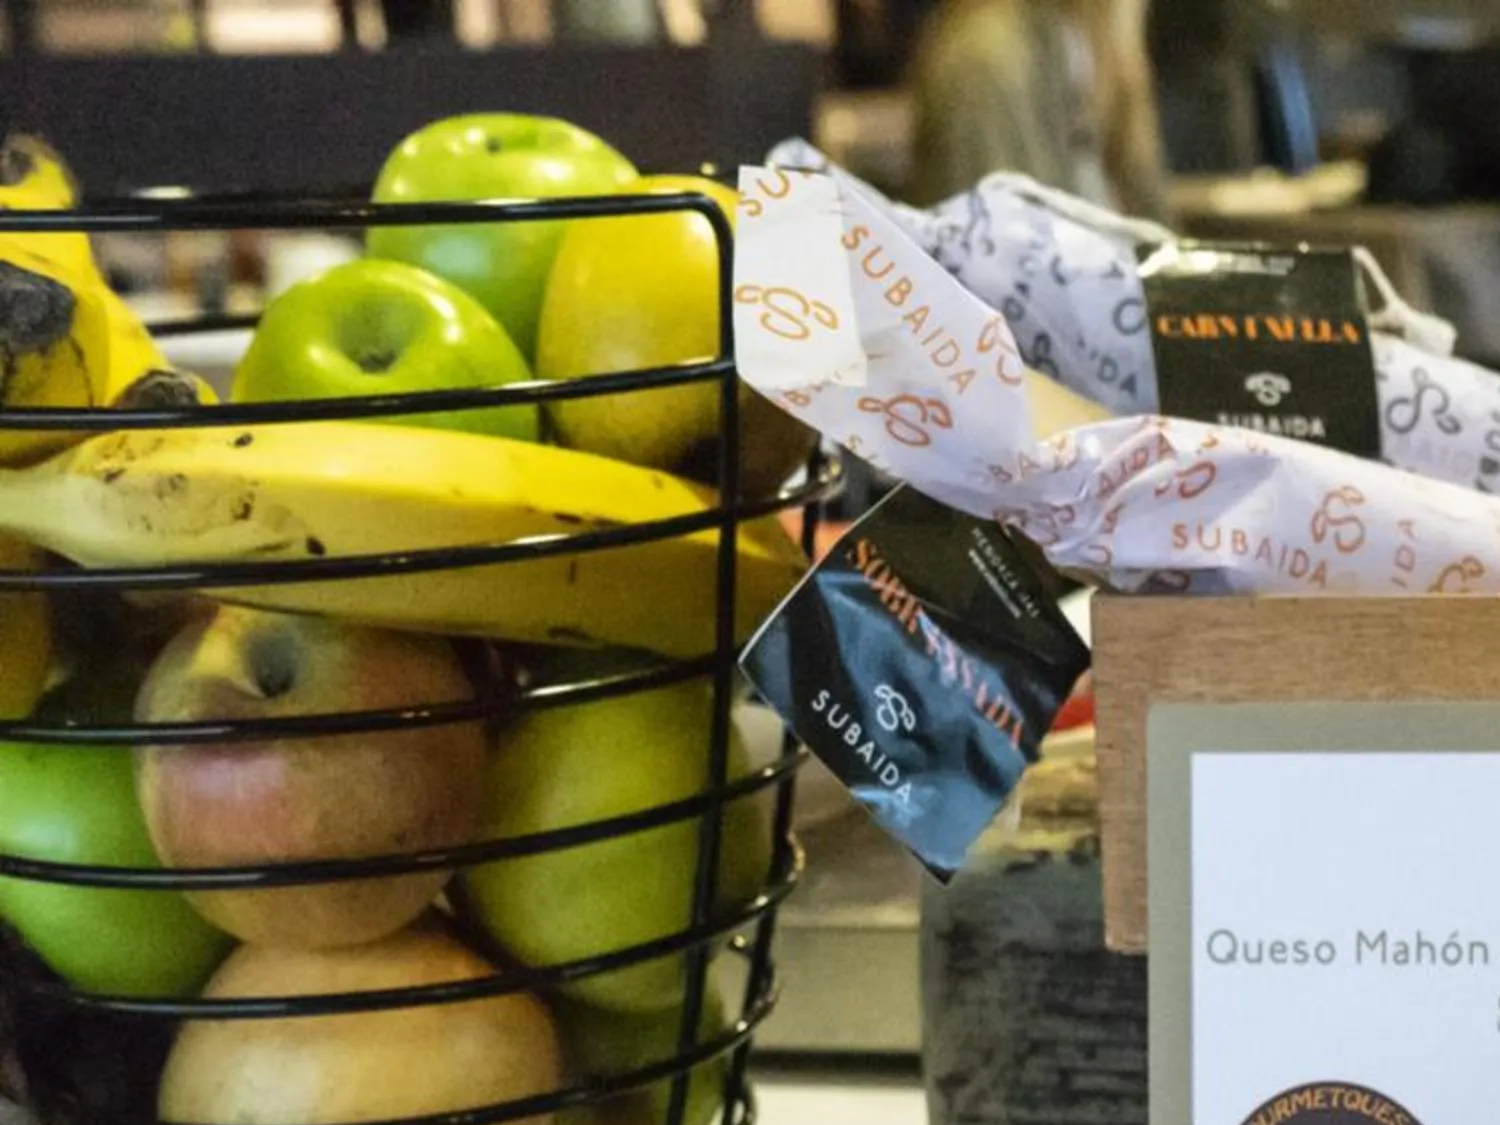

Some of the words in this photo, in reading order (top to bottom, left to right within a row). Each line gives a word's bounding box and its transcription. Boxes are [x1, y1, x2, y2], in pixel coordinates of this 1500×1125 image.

[841, 224, 976, 395] SUBAIDA
[1172, 523, 1328, 589] SUBAIDA
[811, 690, 912, 804] SUBAIDA
[1206, 928, 1336, 965] Queso
[1355, 930, 1489, 966] Mahón
